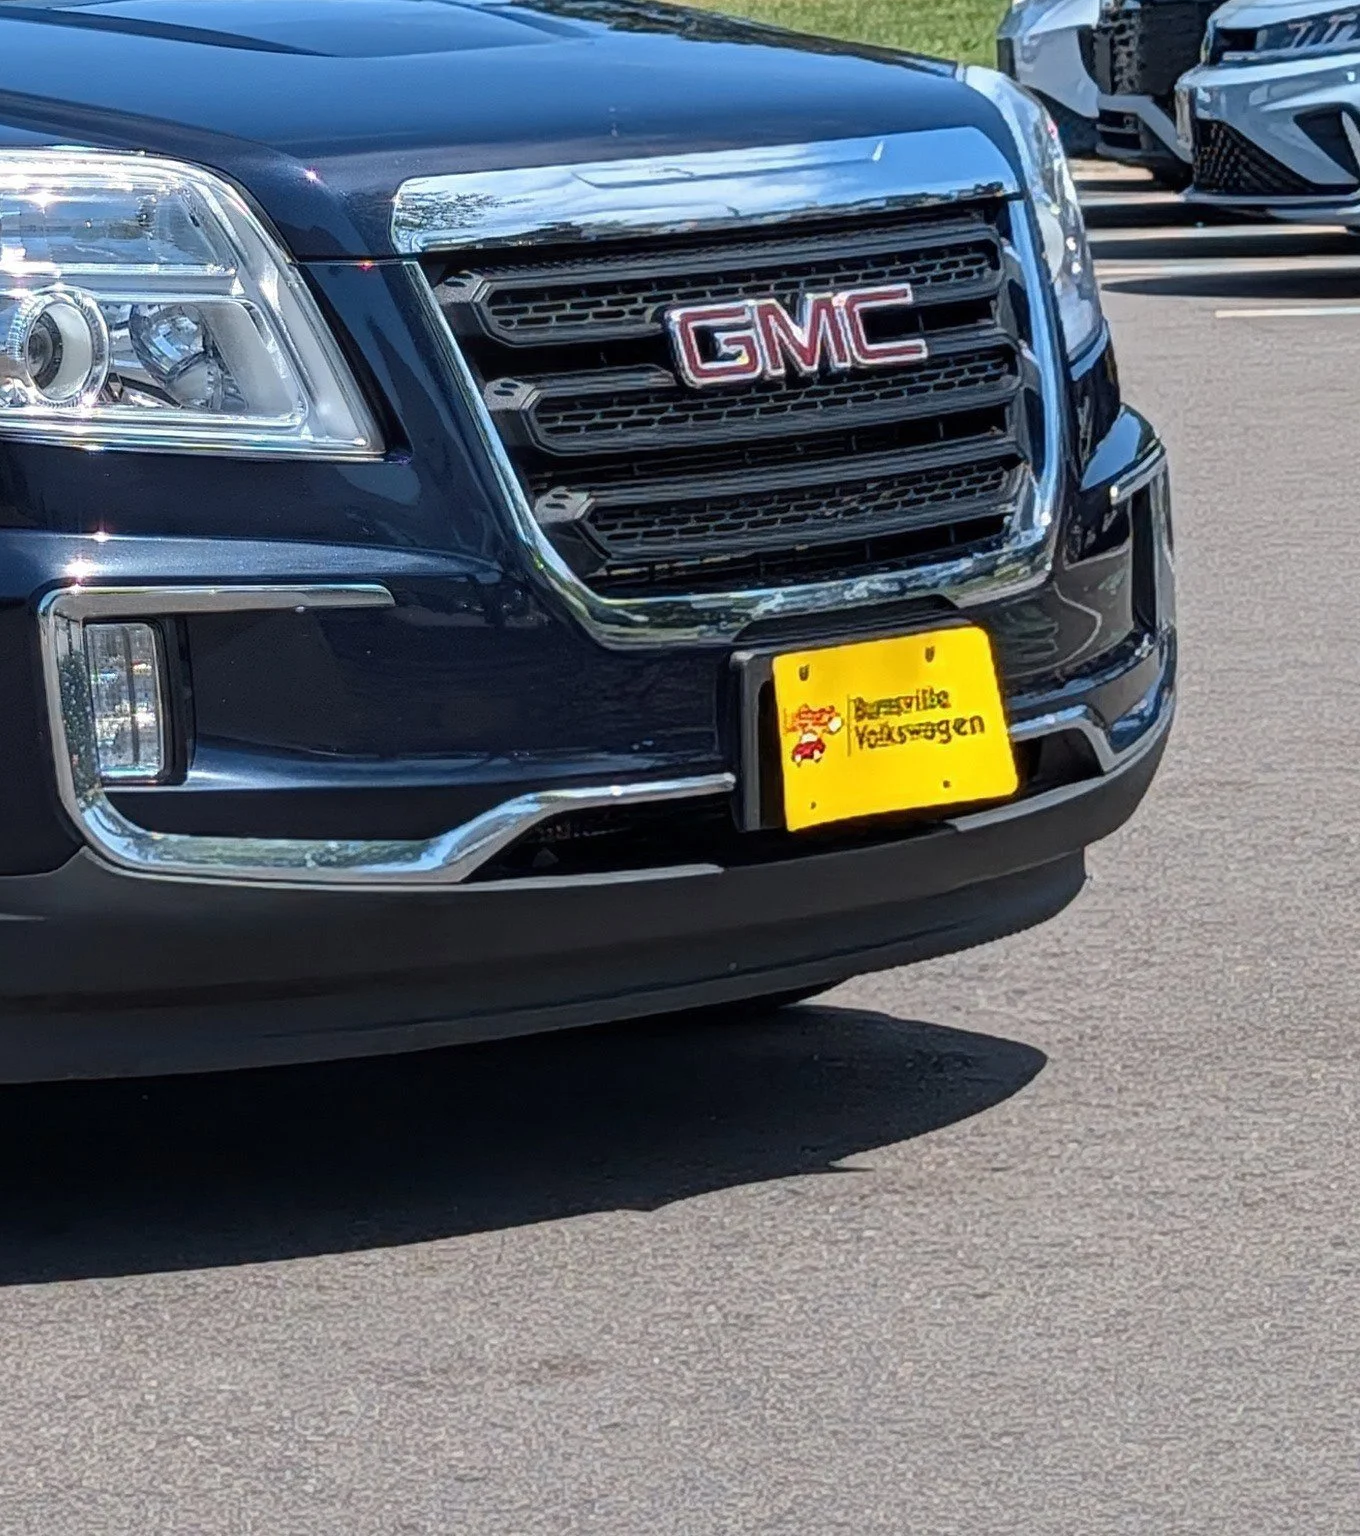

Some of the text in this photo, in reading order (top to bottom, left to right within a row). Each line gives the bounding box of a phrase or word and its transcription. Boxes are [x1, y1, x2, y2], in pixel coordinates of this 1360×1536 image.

[665, 283, 928, 388] GMC
[854, 687, 951, 722] Burnsville
[854, 715, 985, 750] Volkswagen
